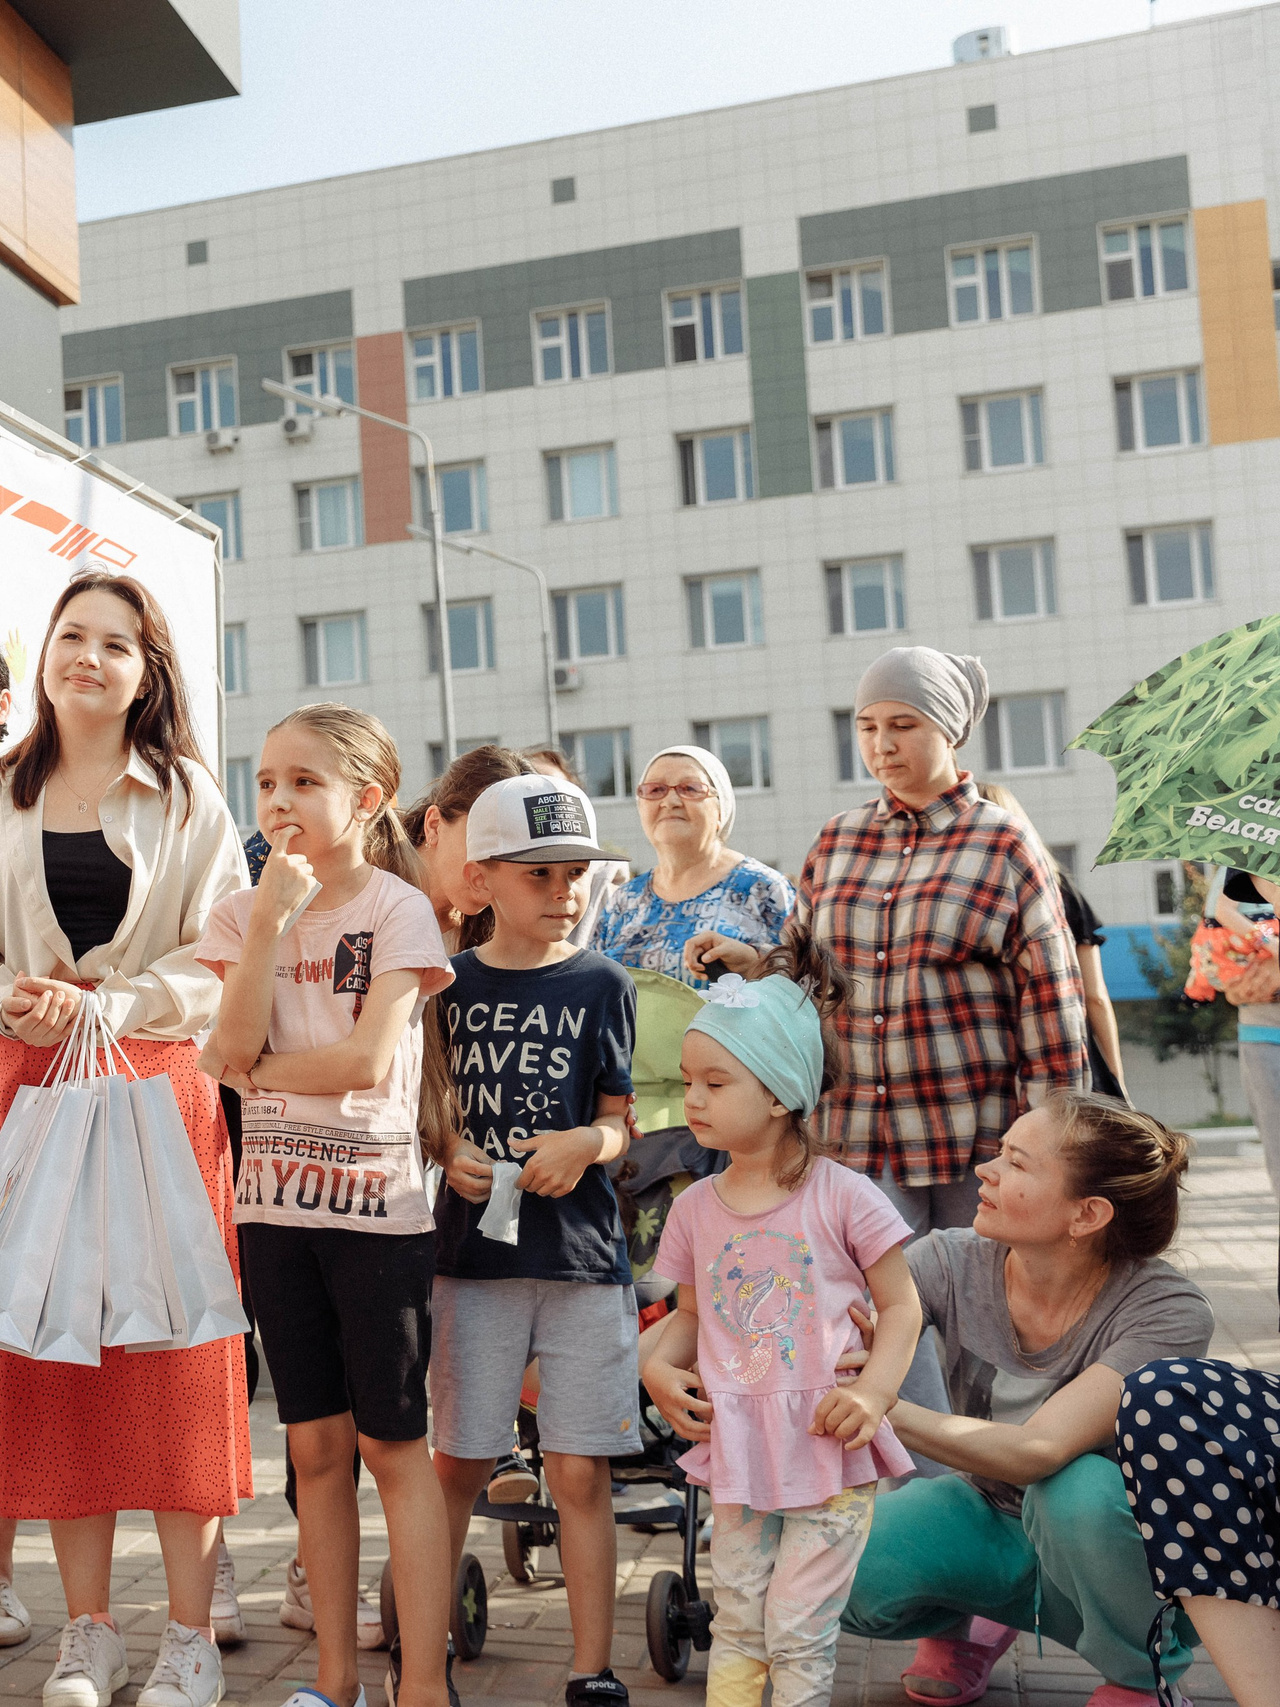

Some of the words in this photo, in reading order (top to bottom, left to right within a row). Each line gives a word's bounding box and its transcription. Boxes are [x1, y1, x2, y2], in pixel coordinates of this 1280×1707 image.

[538, 794, 564, 805] ABOUT
[1185, 805, 1280, 846] Белая
[448, 1002, 586, 1039] OCEAN
[450, 1041, 571, 1079] WAVES
[458, 1083, 502, 1116] UN
[283, 1124, 301, 1132] FREE
[303, 1126, 324, 1135] STYLE
[325, 1129, 364, 1140] CAREFULLY
[272, 1159, 388, 1217] YOUR
[585, 1680, 617, 1690] sports
